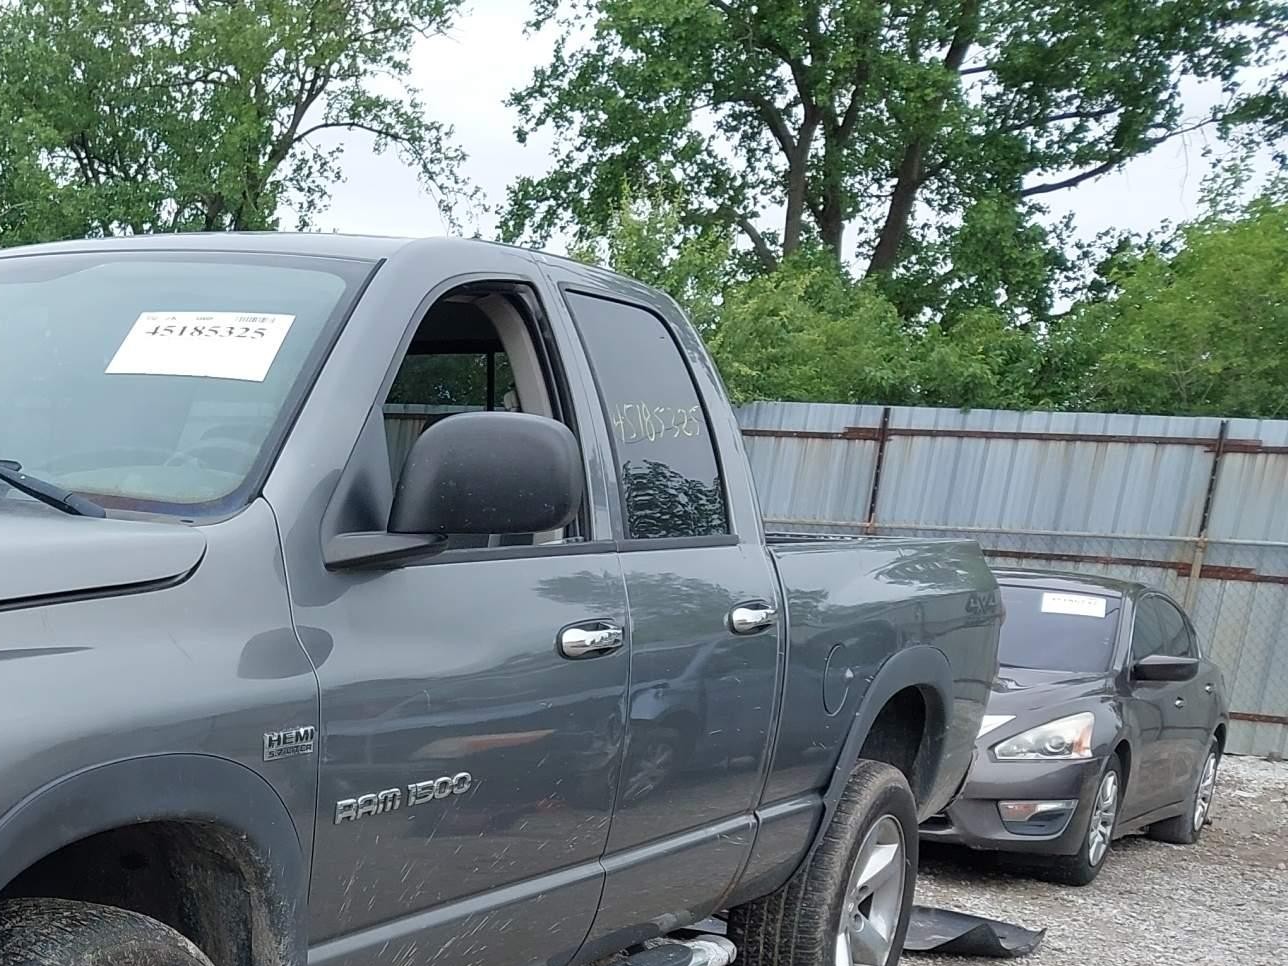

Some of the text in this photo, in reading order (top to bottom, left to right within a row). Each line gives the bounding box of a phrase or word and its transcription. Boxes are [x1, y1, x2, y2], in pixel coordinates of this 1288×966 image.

[145, 325, 268, 340] 45185325
[613, 401, 701, 442] 45185325
[268, 728, 315, 748] HEMI
[333, 771, 472, 825] RAM 1500
